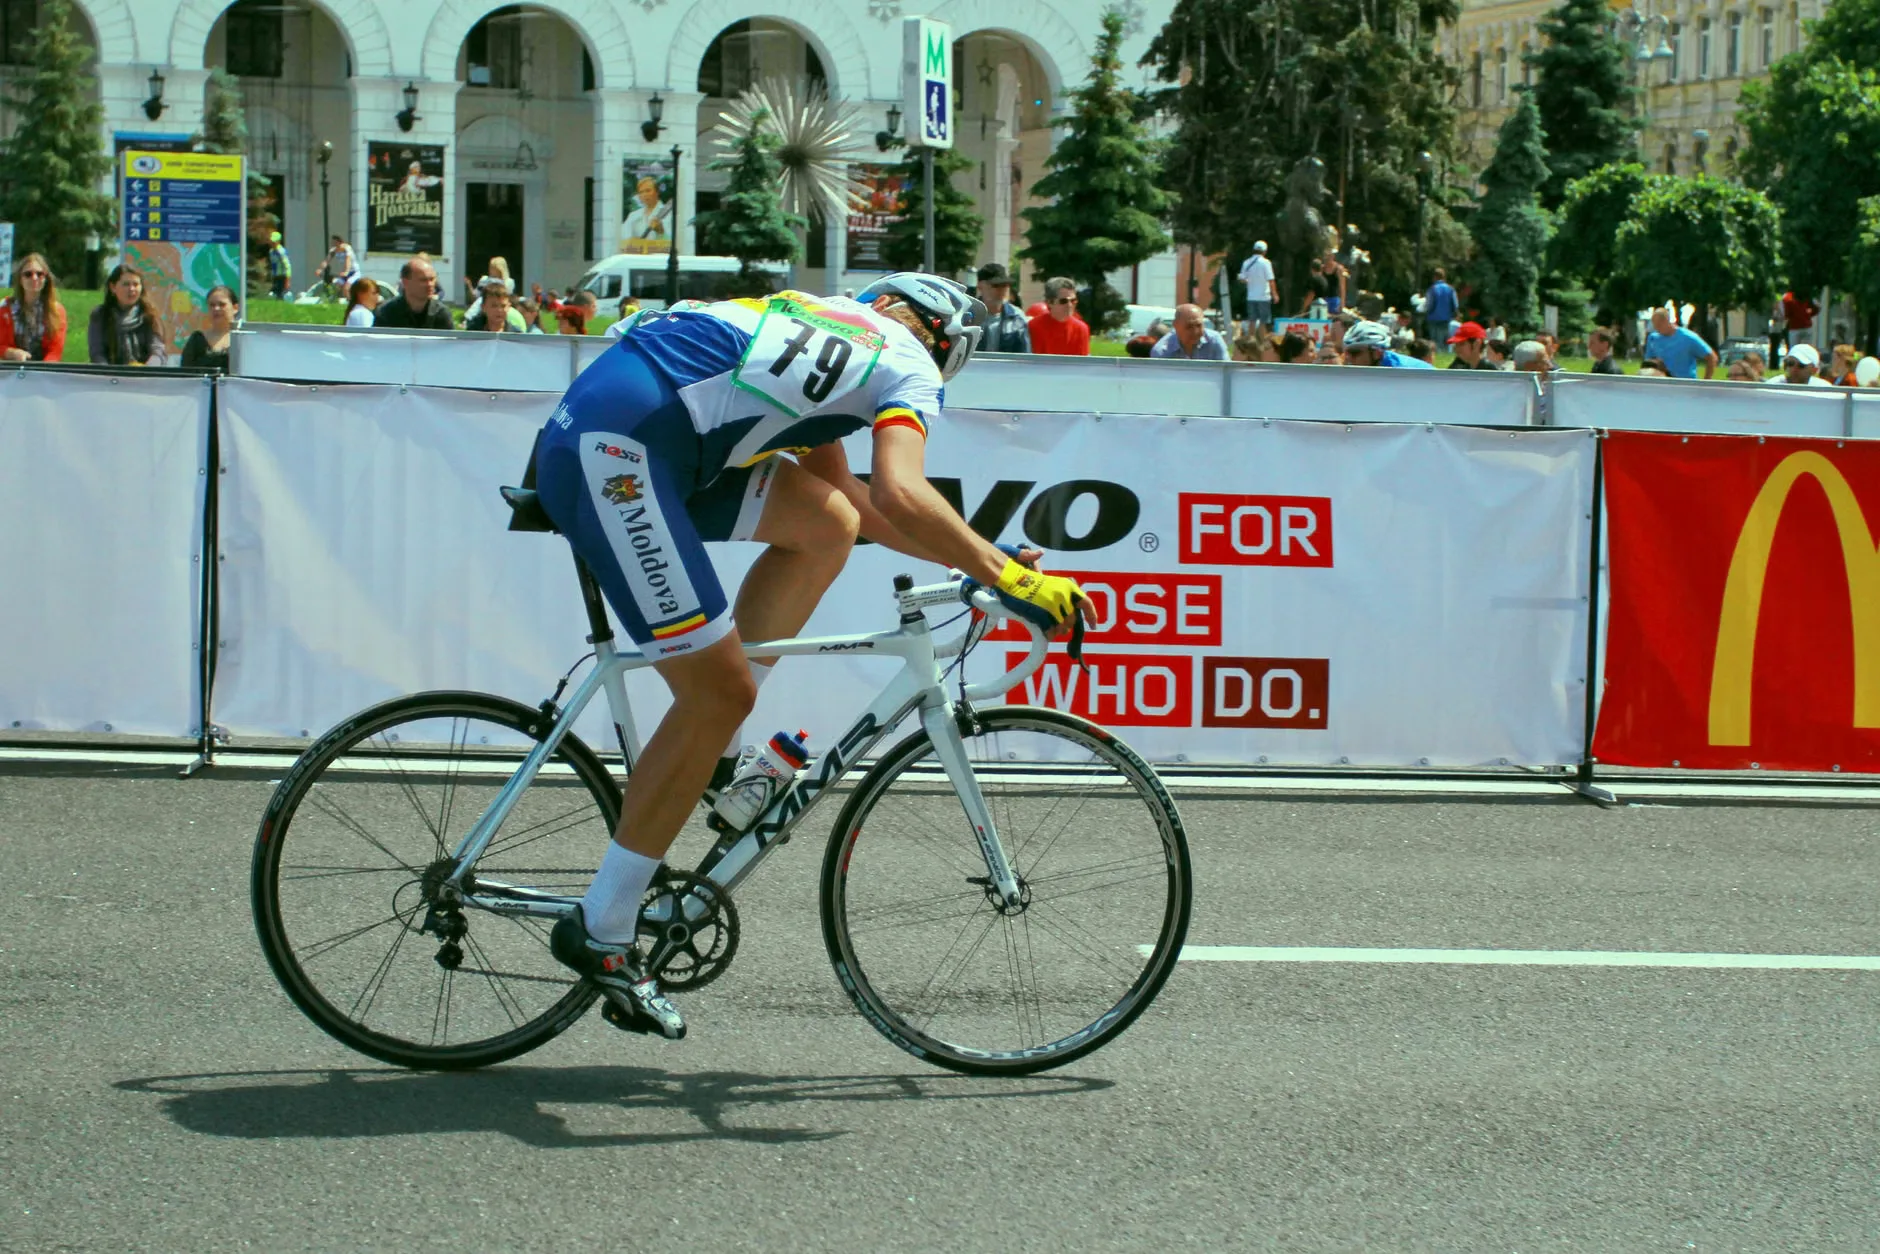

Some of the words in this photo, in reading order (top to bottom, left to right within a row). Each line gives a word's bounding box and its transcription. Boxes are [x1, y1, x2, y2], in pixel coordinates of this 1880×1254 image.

[926, 27, 945, 77] M
[768, 318, 852, 403] 79
[1192, 504, 1320, 557] FOR
[620, 504, 680, 615] Moldova
[819, 641, 875, 652] MMR
[1022, 664, 1177, 716] WHO
[1213, 667, 1321, 719] DO.
